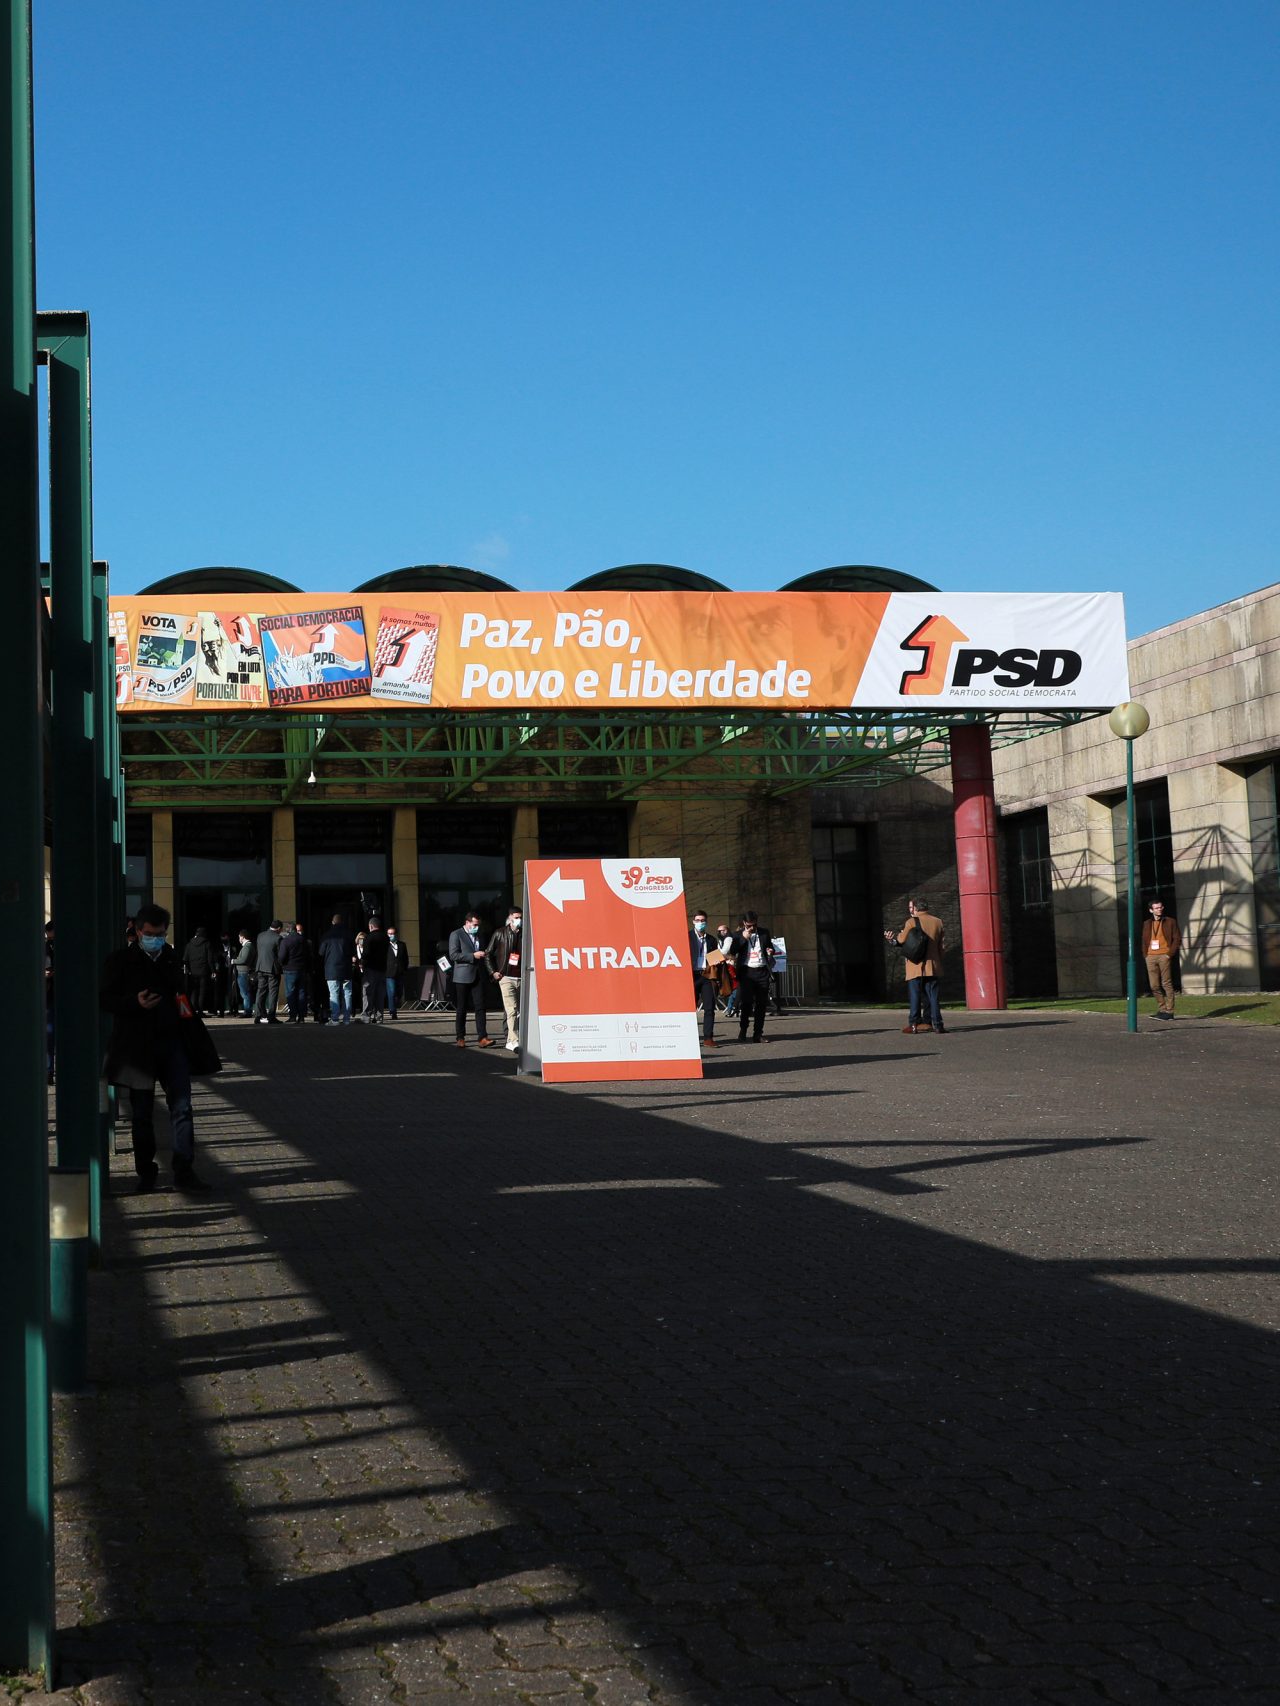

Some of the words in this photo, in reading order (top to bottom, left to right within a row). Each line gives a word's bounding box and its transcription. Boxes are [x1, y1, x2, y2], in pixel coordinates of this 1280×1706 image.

[141, 615, 177, 630] VOTA
[261, 617, 296, 632] SOCIAL
[297, 607, 363, 628] DEMOCRACIA
[389, 617, 412, 626] somos
[412, 620, 436, 628] muitos
[414, 612, 431, 621] hoje
[459, 612, 544, 655] Paz,
[553, 608, 642, 654] Pão,
[313, 651, 336, 666] PPD
[247, 661, 261, 673] LUTA
[951, 647, 1083, 688] PSD
[226, 672, 239, 684] POR
[461, 662, 565, 699] Povo
[574, 668, 599, 699] e
[608, 659, 812, 699] Liberdade
[196, 682, 239, 700] PORTUGAL
[240, 684, 262, 701] LIVRE
[269, 686, 304, 705] PARA
[307, 677, 372, 700] PORTUGAL
[372, 687, 401, 697] seremos
[402, 690, 430, 700] milhões
[949, 689, 986, 697] PARTIDO
[989, 689, 1020, 697] SOCIAL
[1023, 689, 1077, 697] DEMOCRATA
[620, 866, 650, 889] 39º
[646, 876, 673, 885] PSD
[543, 945, 682, 970] ENTRADA
